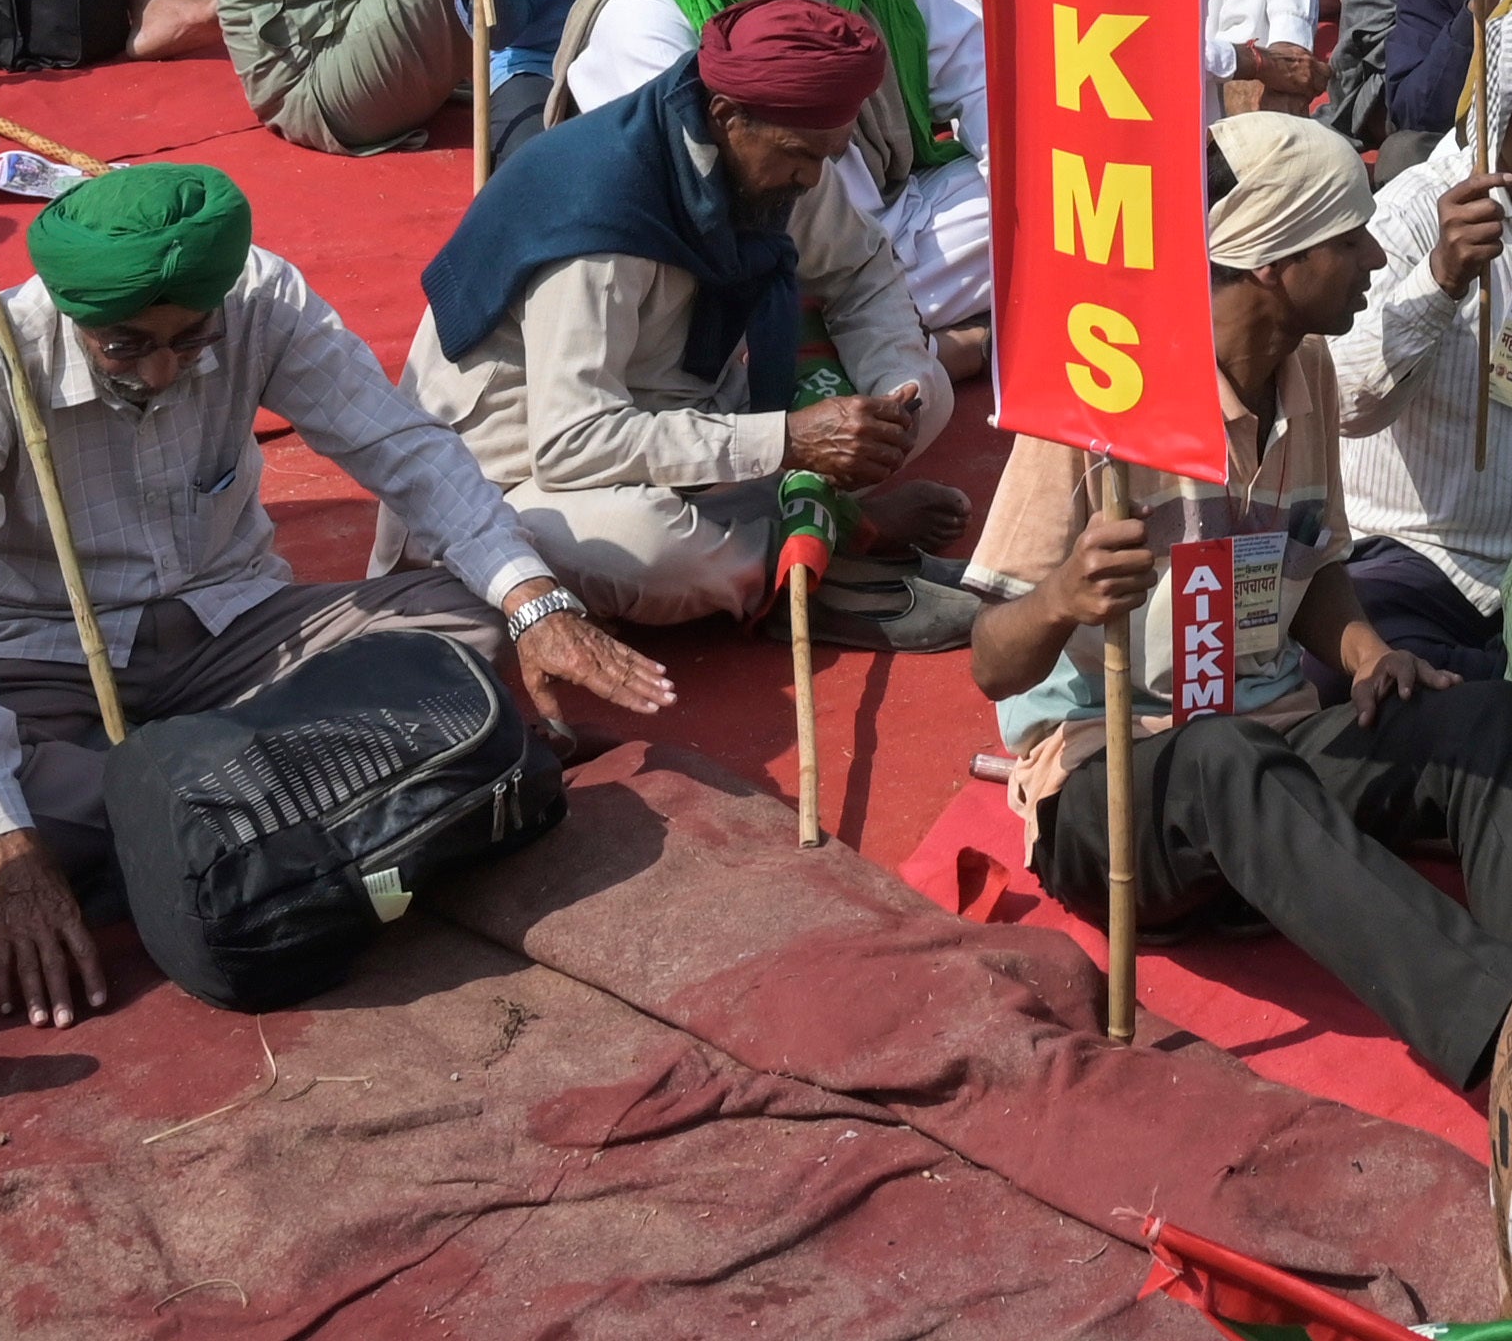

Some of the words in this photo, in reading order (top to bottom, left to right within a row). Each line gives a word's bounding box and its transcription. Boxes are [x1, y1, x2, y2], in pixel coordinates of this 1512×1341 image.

[1028, 163, 1149, 414] AIKKMS
[1181, 564, 1225, 723] AIKKM
[1234, 575, 1277, 601] हापंचायत
